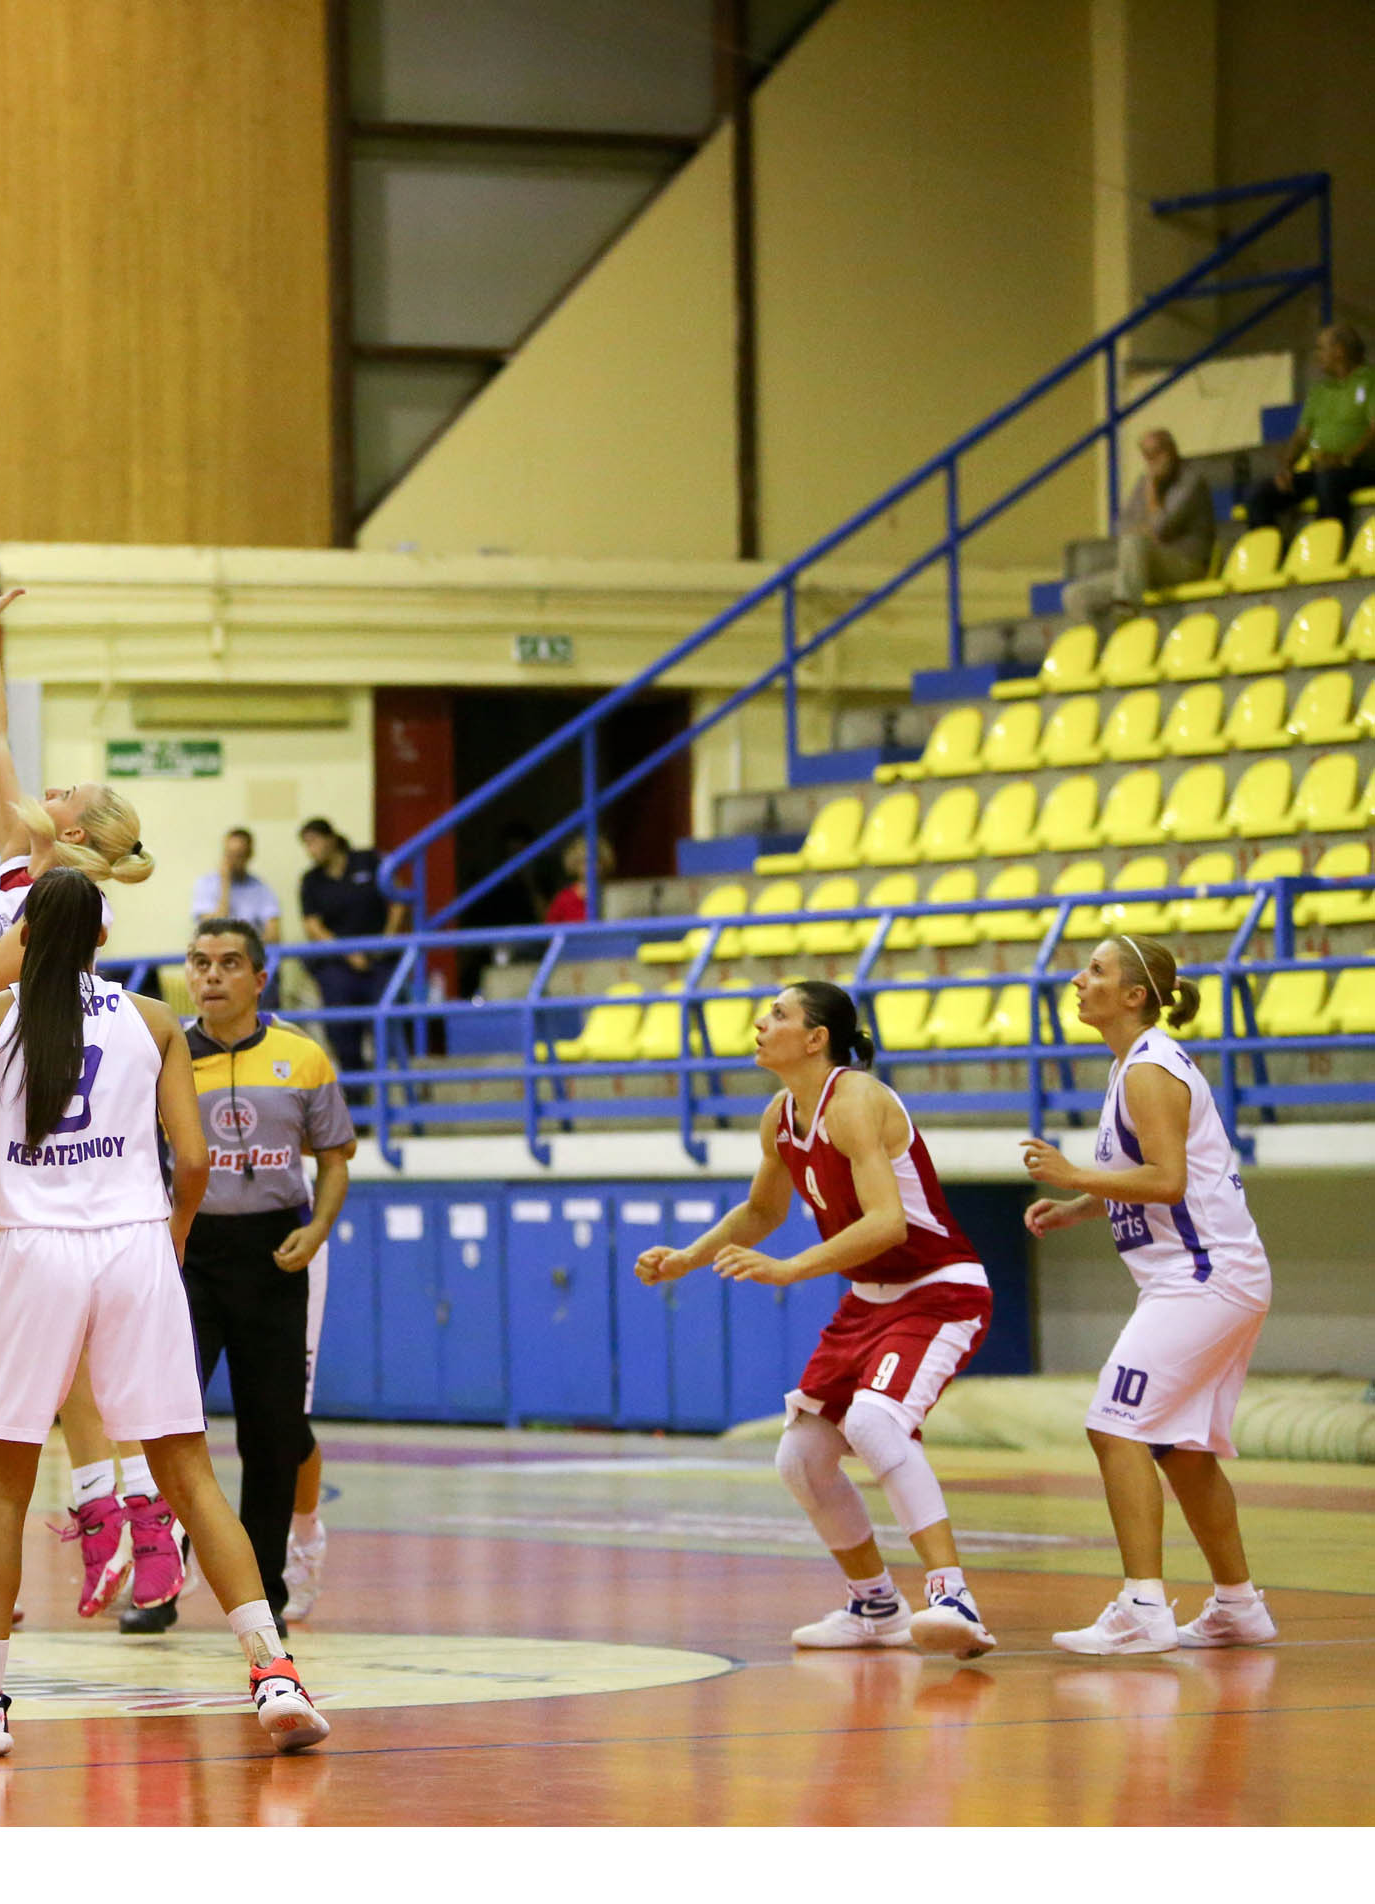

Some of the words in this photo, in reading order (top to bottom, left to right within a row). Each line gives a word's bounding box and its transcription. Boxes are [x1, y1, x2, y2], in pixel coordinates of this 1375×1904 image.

[7, 1137, 125, 1166] ΚΕΡΑΤΣΙΝΙΟΥ
[805, 1166, 827, 1210] 9
[1112, 1216, 1144, 1242] orts
[871, 1352, 900, 1391] 9
[1112, 1365, 1148, 1407] 10
